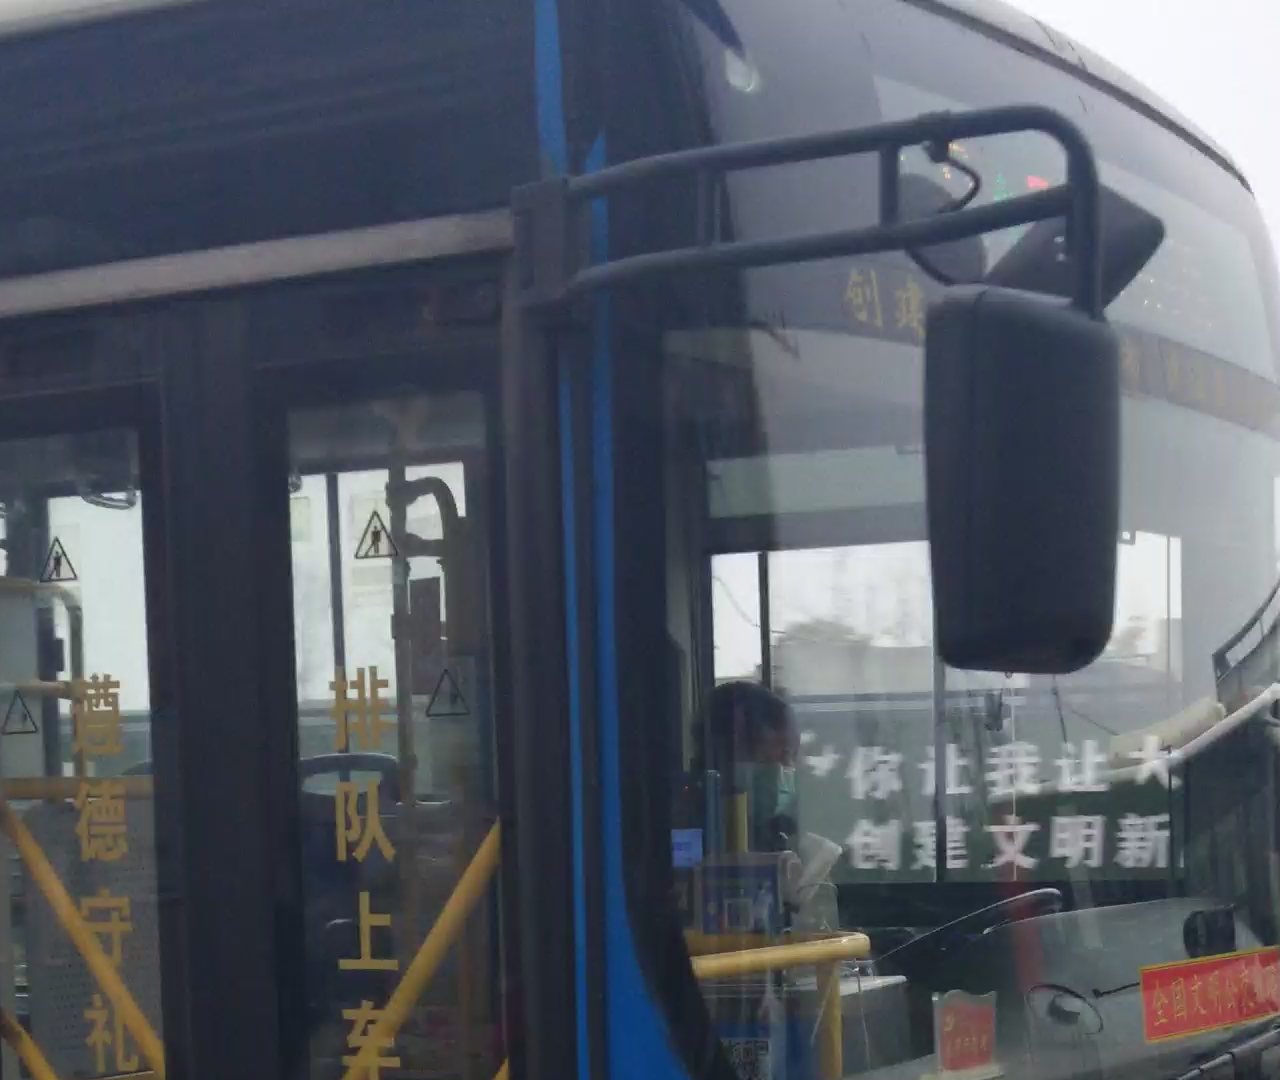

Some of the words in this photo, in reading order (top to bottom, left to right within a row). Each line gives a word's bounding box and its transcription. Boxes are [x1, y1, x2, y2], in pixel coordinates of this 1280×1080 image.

[70, 673, 139, 1073] 遵德守礼
[843, 811, 1185, 871] 创建文明新
